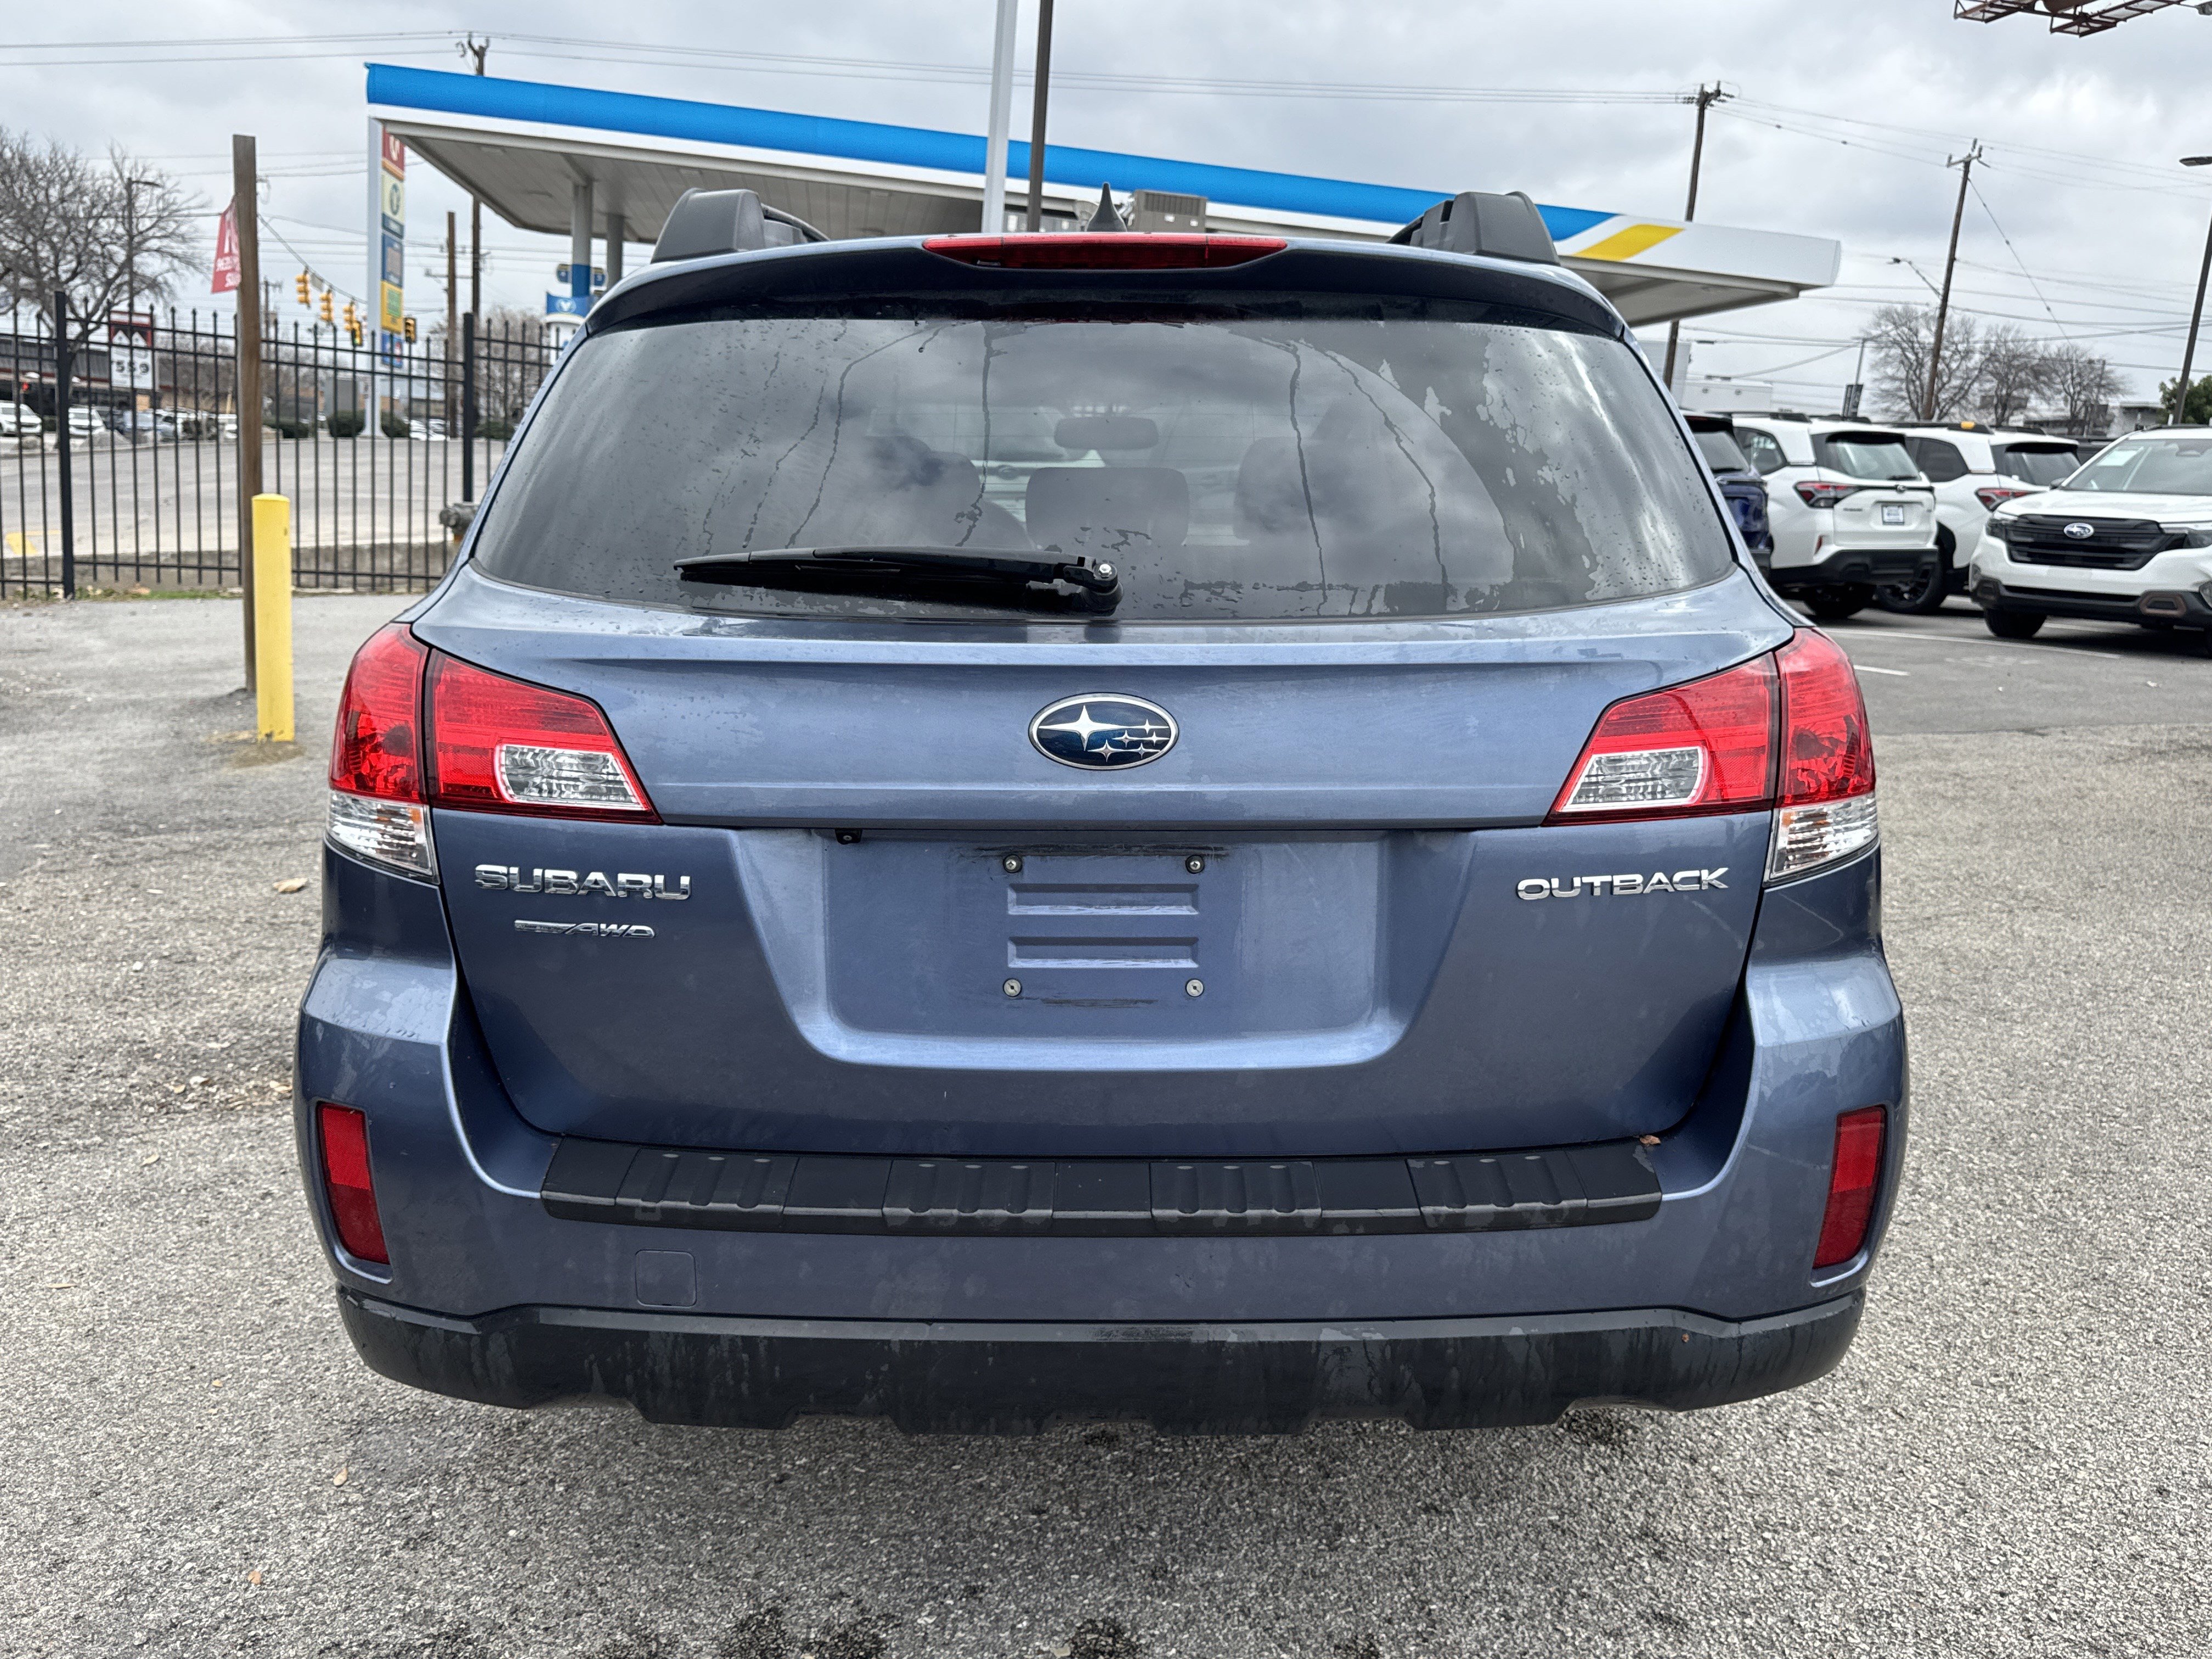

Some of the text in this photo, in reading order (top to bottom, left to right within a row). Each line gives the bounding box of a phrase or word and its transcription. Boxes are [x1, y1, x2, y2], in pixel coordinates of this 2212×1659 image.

[475, 864, 691, 900] SUBARU
[1517, 867, 1729, 900] OUTBACK
[565, 923, 656, 939] AWD
